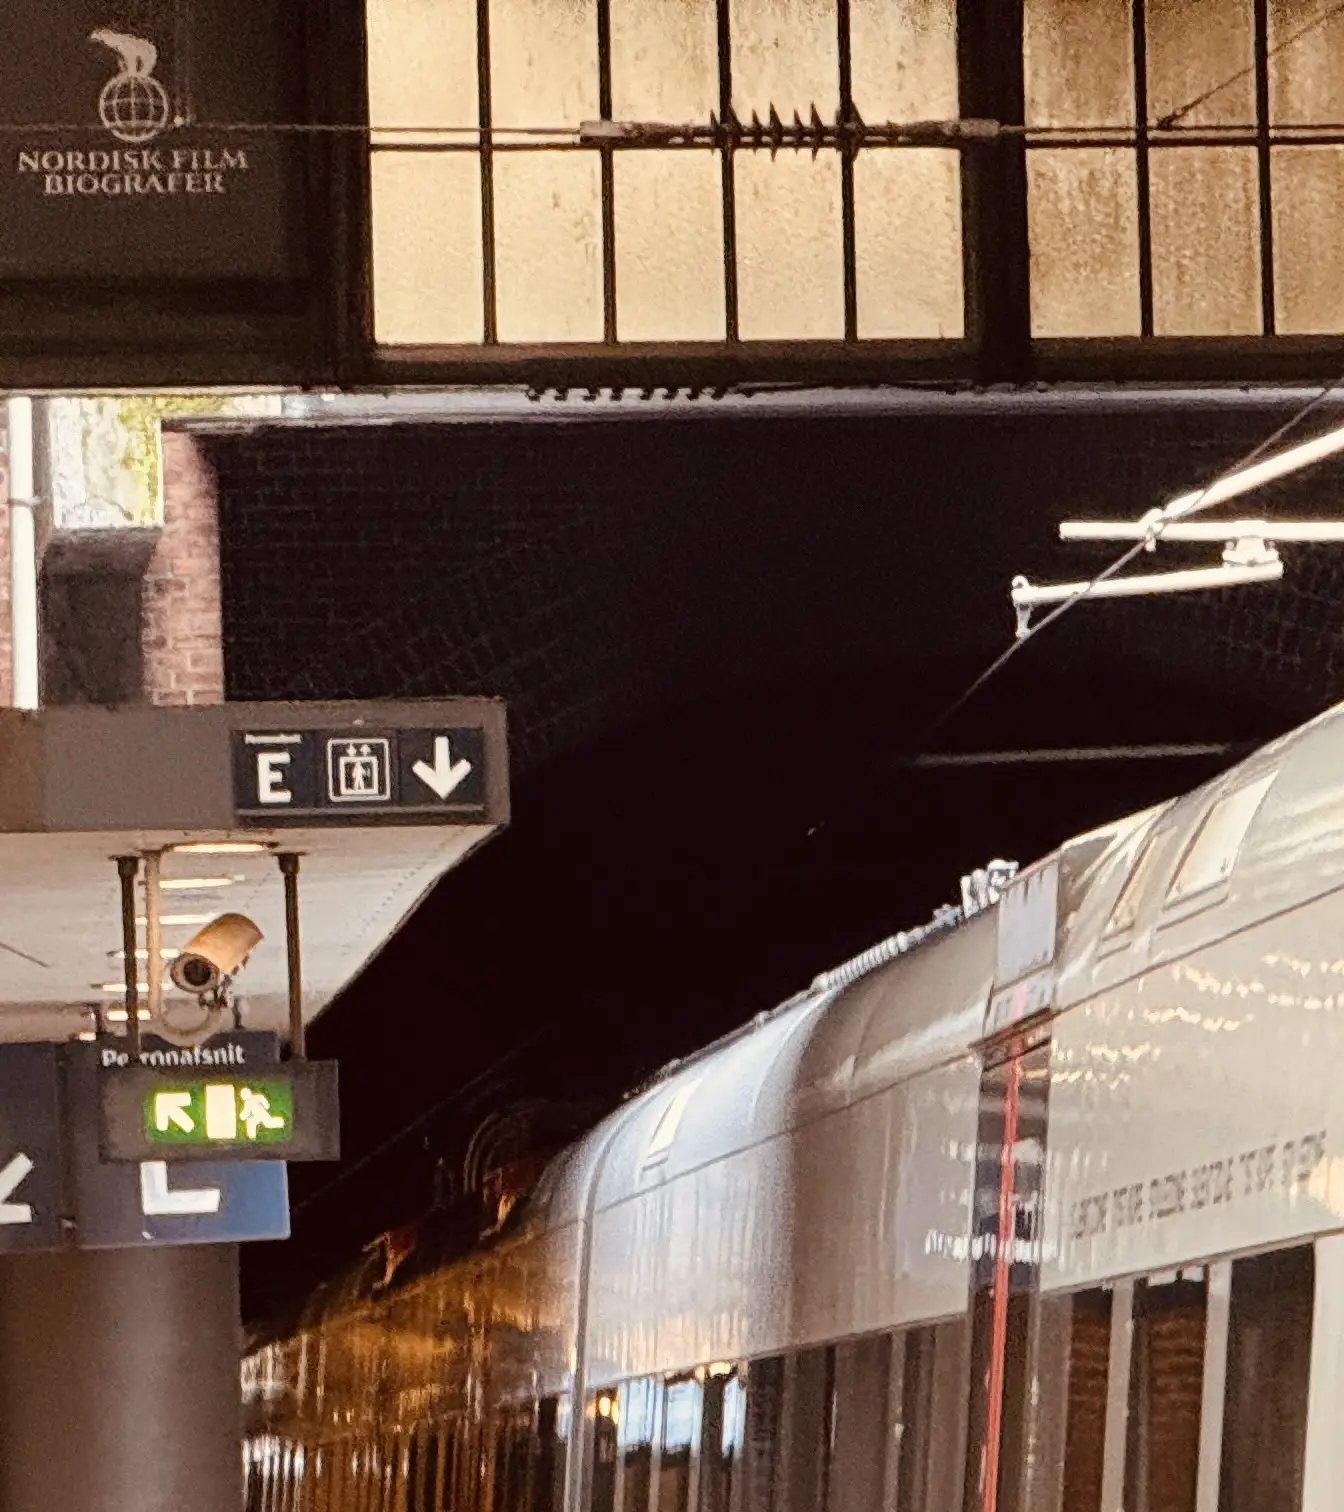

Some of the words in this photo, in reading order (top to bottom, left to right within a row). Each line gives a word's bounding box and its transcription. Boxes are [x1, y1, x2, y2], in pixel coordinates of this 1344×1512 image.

[18, 151, 163, 172] NORDISK
[173, 149, 249, 170] FILM
[44, 173, 225, 194] BIOGRAFER
[258, 752, 291, 803] E
